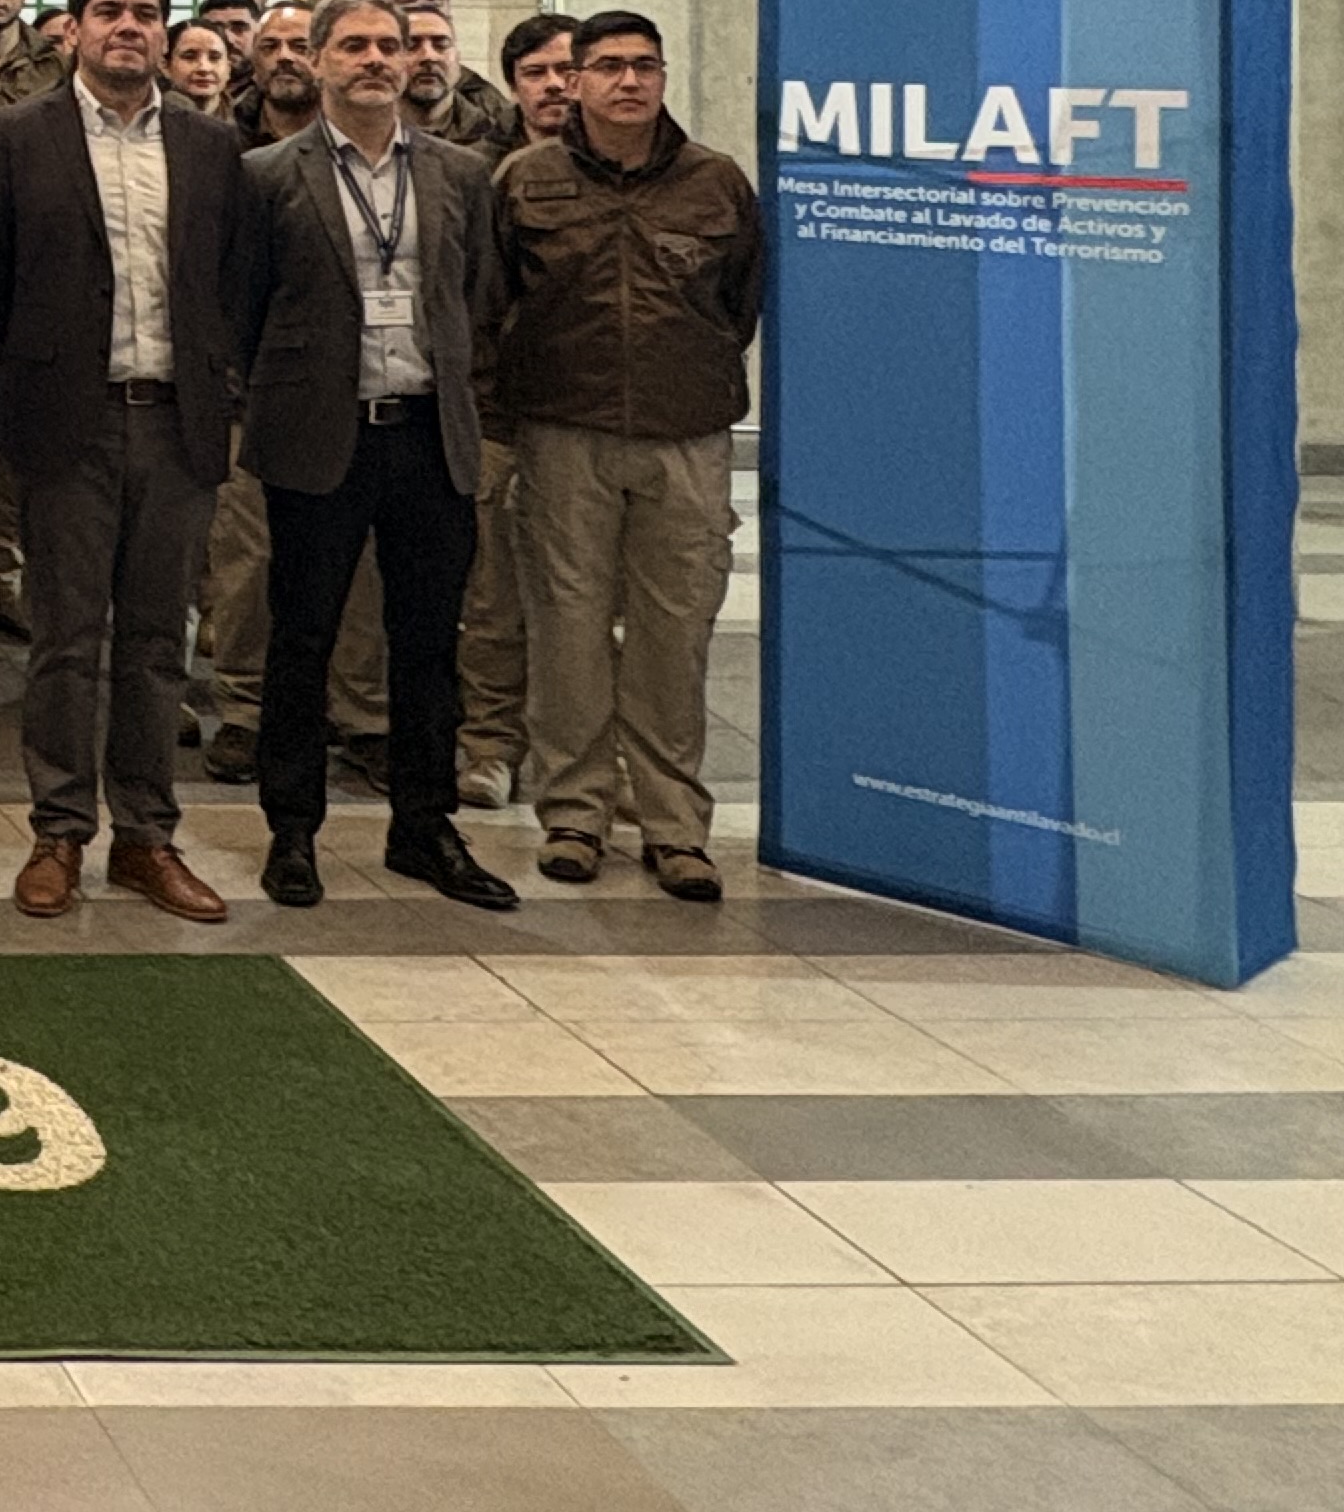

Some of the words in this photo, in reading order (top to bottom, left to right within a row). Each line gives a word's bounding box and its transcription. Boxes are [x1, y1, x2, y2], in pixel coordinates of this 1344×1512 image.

[777, 80, 1189, 169] MILAFT
[777, 176, 829, 196] Mesa
[833, 180, 975, 206] Intersectorial
[981, 187, 1046, 209] sobre
[1052, 192, 1190, 216] Prevención
[794, 202, 809, 220] y
[811, 200, 906, 224] Combate
[912, 206, 931, 226] al
[937, 208, 1014, 230] Lavado
[1022, 212, 1052, 233] de
[1058, 217, 1146, 239] Activos
[1151, 223, 1167, 244] y
[797, 222, 816, 238] al
[820, 222, 984, 251] Financiamiento
[991, 233, 1026, 254] del
[1032, 236, 1164, 264] Terrorismo
